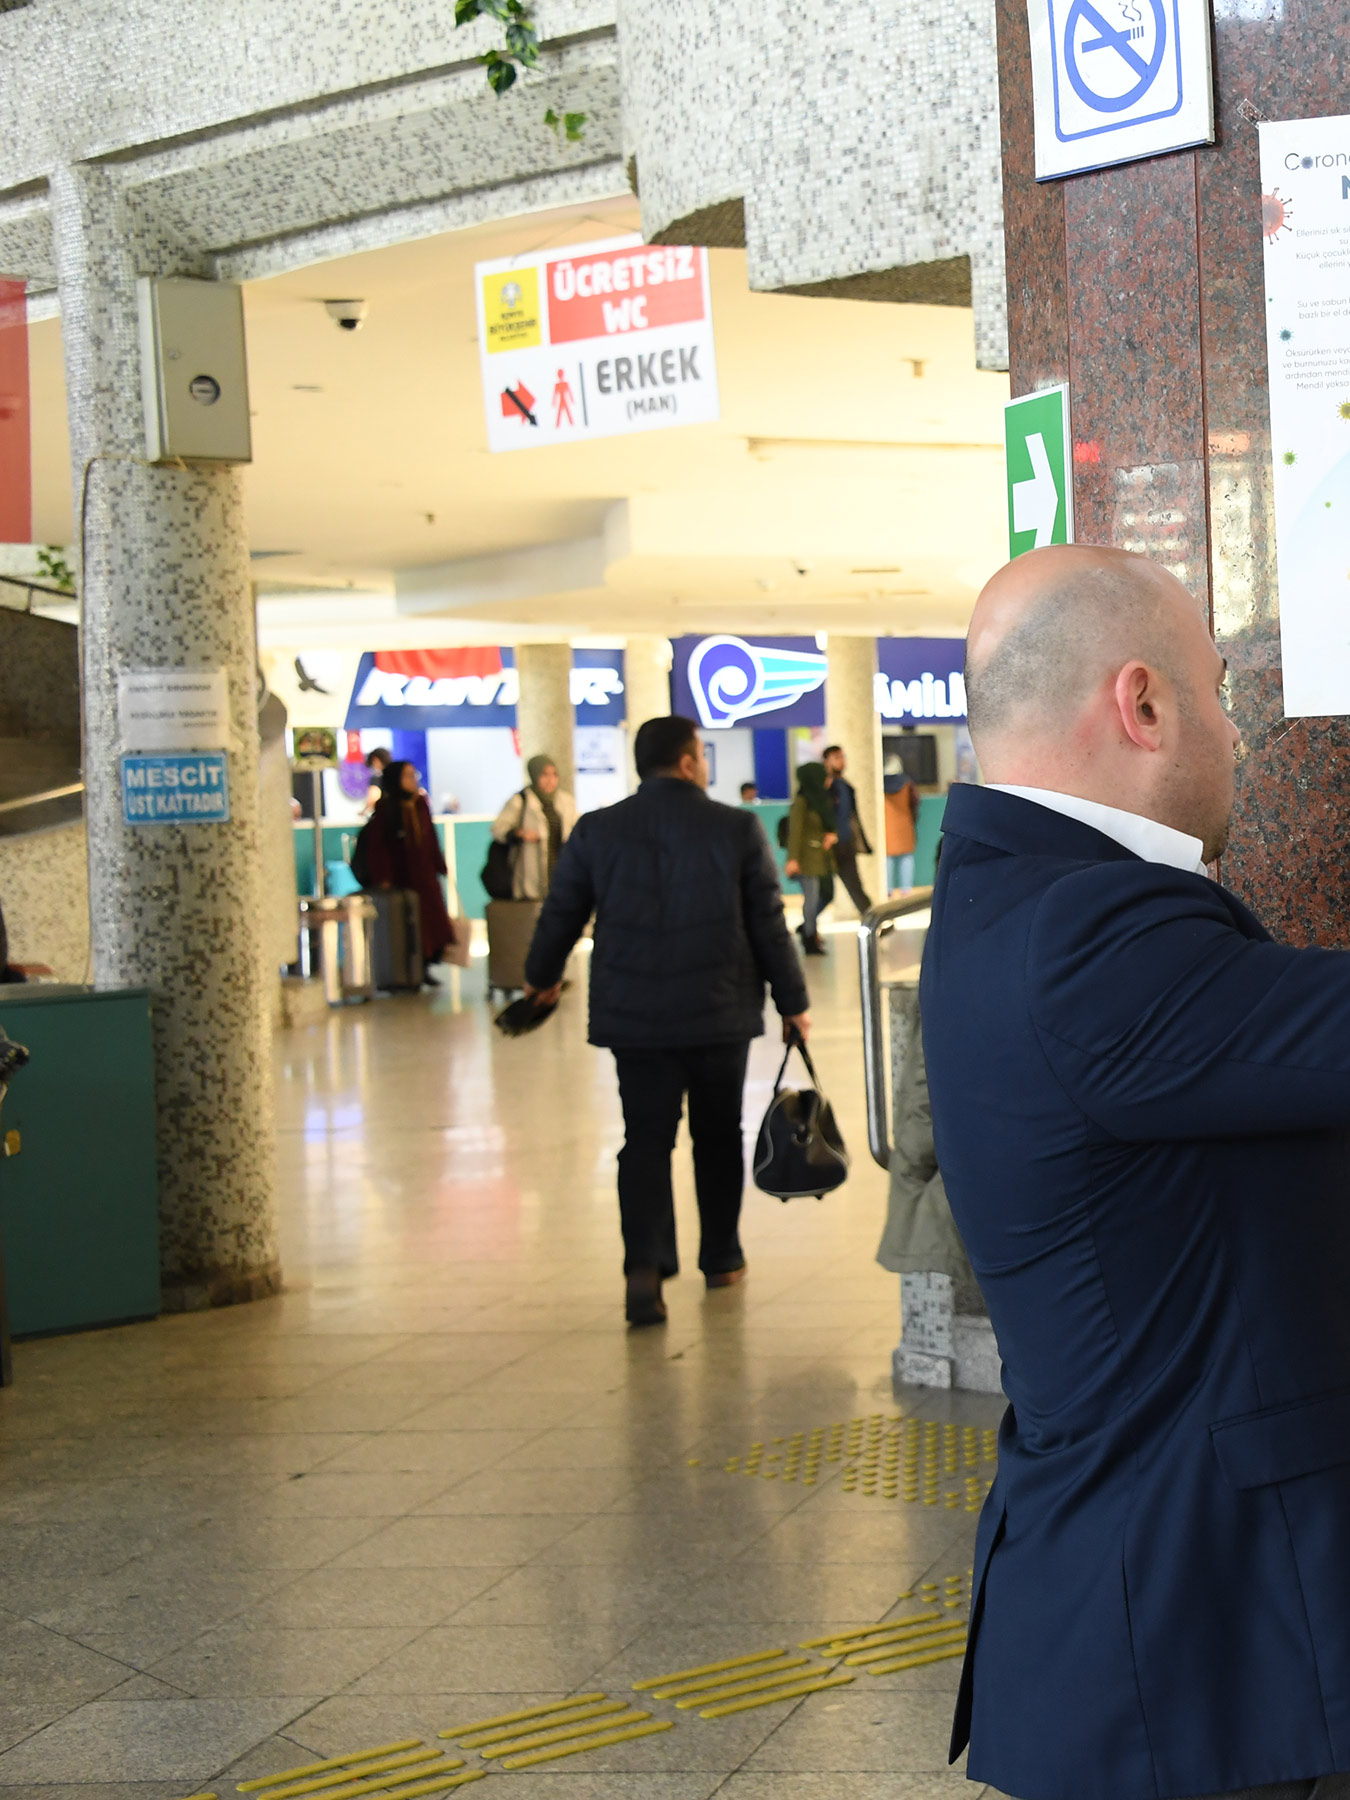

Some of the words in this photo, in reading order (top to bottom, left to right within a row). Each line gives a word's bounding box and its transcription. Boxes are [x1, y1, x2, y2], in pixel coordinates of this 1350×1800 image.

[552, 246, 695, 302] ÜCRETSİZ
[602, 295, 649, 334] WC
[596, 345, 701, 395] ERKEK
[626, 394, 677, 421] (MAN)
[126, 761, 222, 789] MESCİT
[128, 792, 154, 816] ÜST
